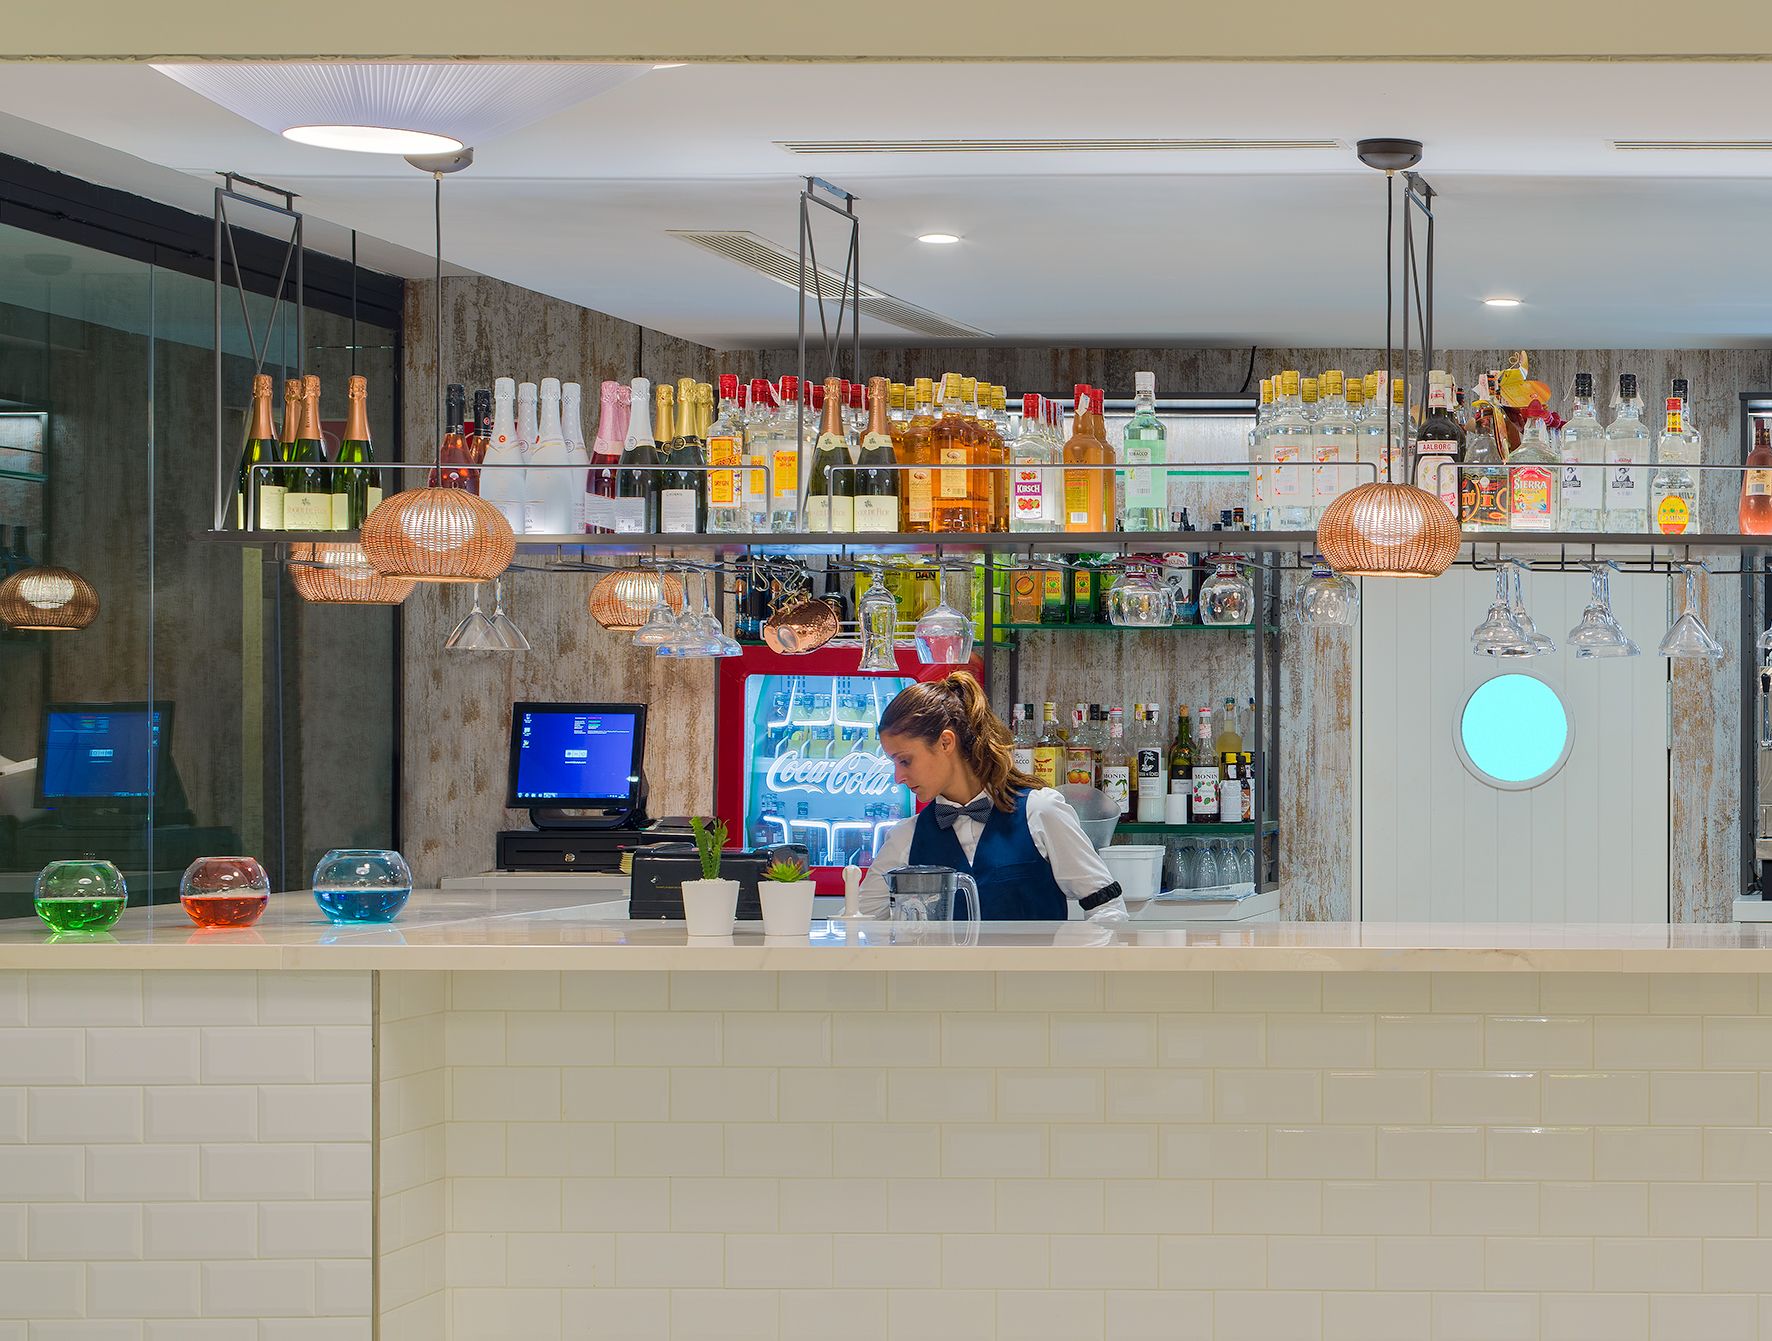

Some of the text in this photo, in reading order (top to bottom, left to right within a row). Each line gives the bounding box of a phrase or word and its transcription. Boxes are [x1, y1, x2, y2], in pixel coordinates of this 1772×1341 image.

[1422, 443, 1452, 451] AALBORG
[1016, 484, 1040, 493] KIRSCH
[1513, 478, 1548, 490] SIERRA
[766, 750, 893, 796] Coca-Cola
